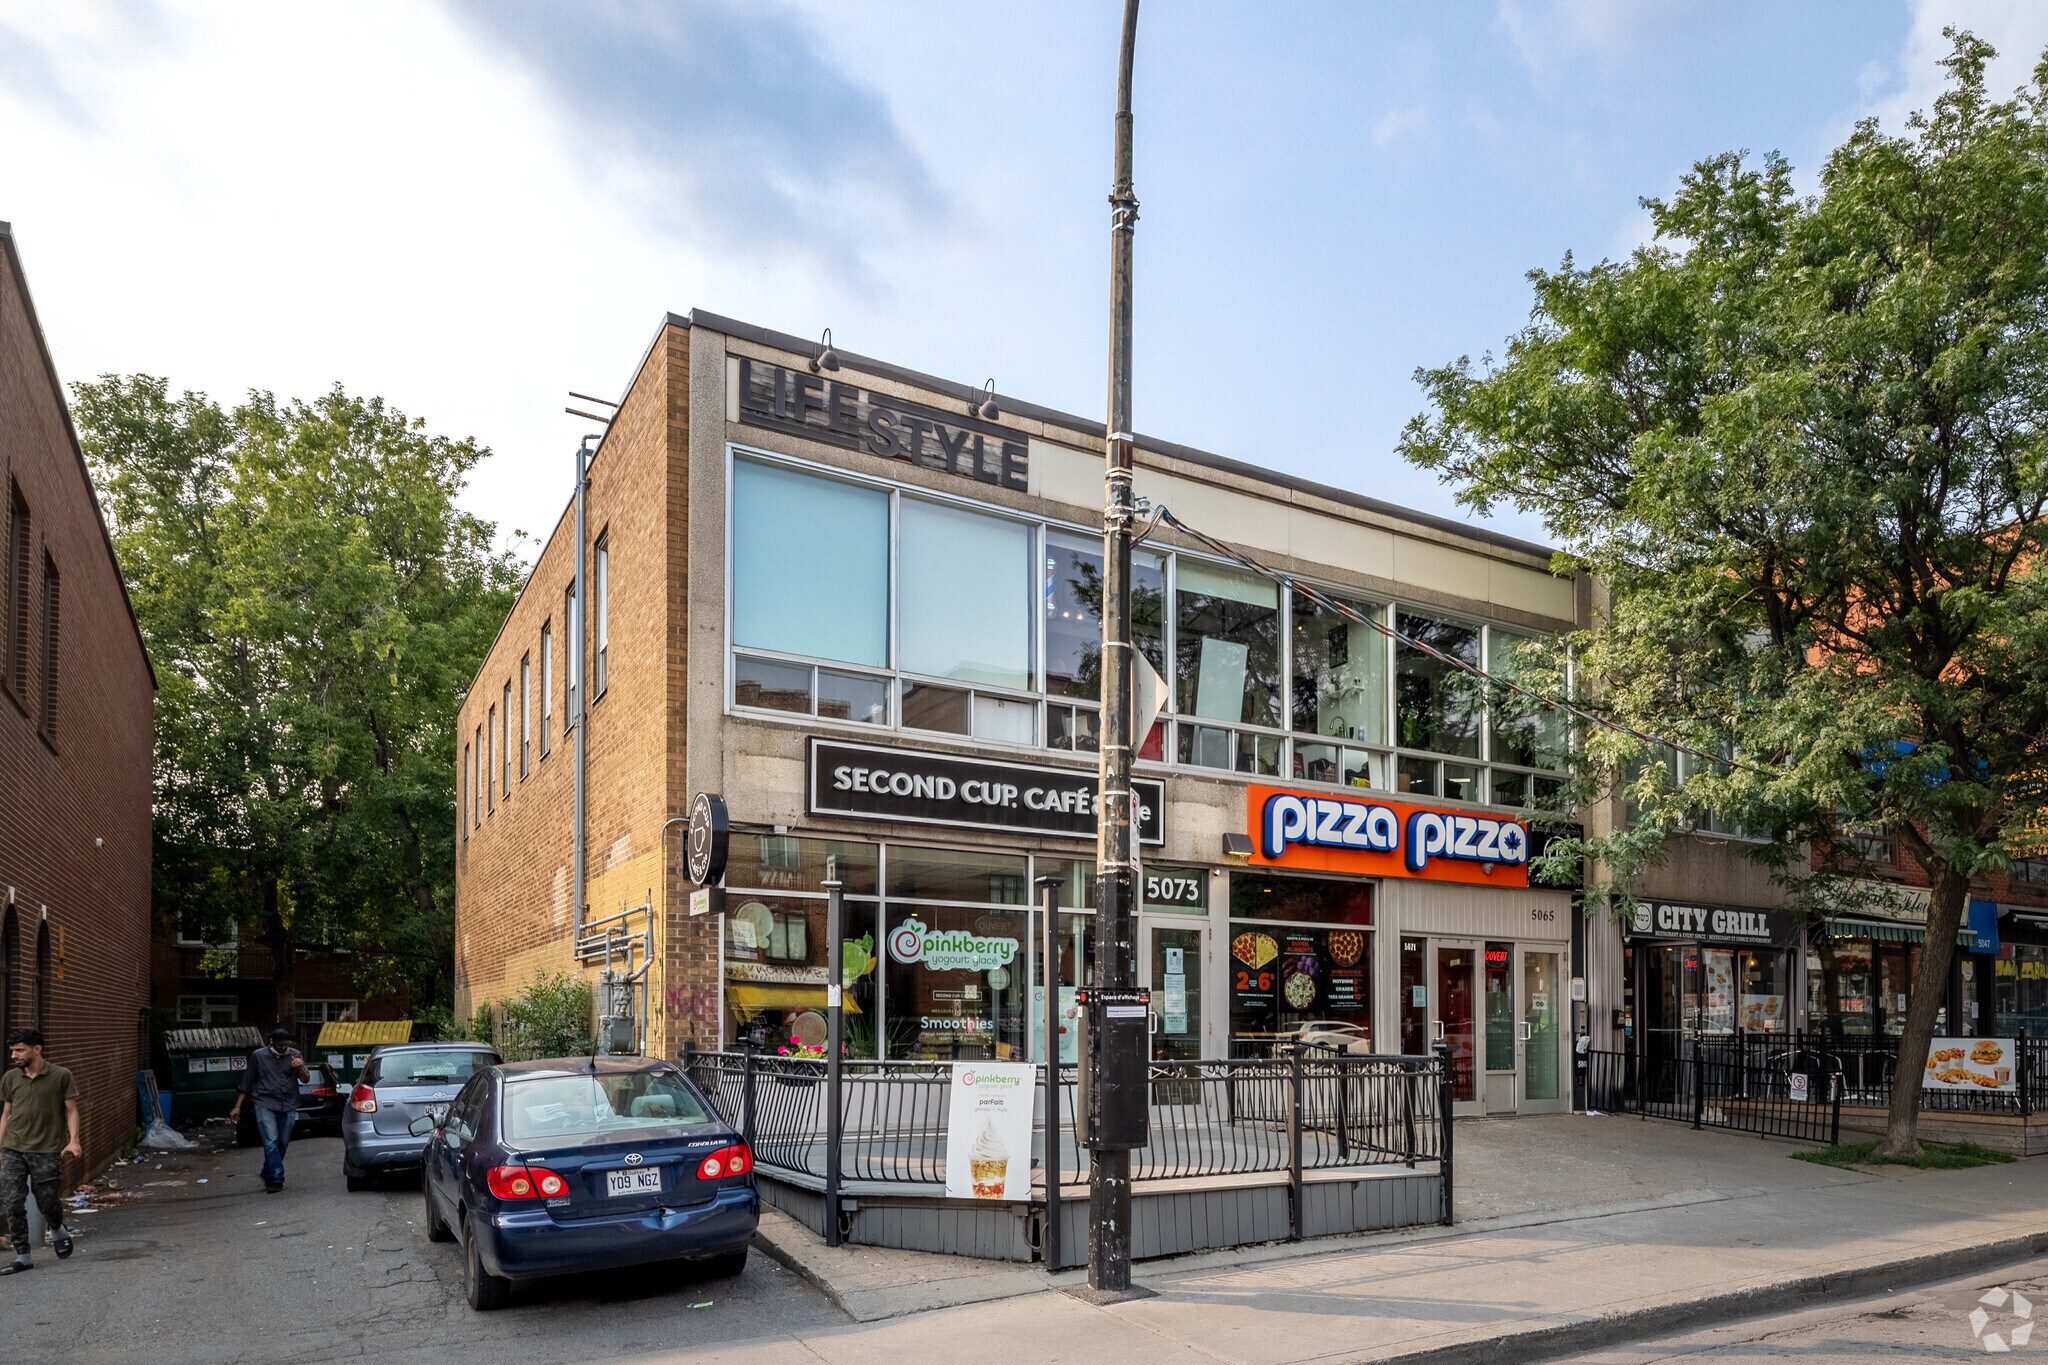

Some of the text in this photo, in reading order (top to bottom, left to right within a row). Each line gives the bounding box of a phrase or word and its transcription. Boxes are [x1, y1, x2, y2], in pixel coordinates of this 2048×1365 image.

[833, 765, 957, 800] SECOND
[1023, 786, 1090, 815] CAFÉ
[1147, 876, 1199, 901] 5073
[1531, 909, 1555, 922] 5065
[1658, 904, 1770, 936] CITY GRILL
[922, 935, 1011, 960] pinkberry
[1978, 939, 1991, 948] 5047
[932, 955, 998, 966] yogourt glacé
[1485, 950, 1508, 962] OUVERT
[1236, 971, 1249, 990] 2
[1100, 994, 1117, 1002] Espace
[920, 1015, 994, 1030] Smoothies
[976, 1074, 1020, 1086] pinkberry
[610, 1172, 659, 1190] Y09 NGZ
